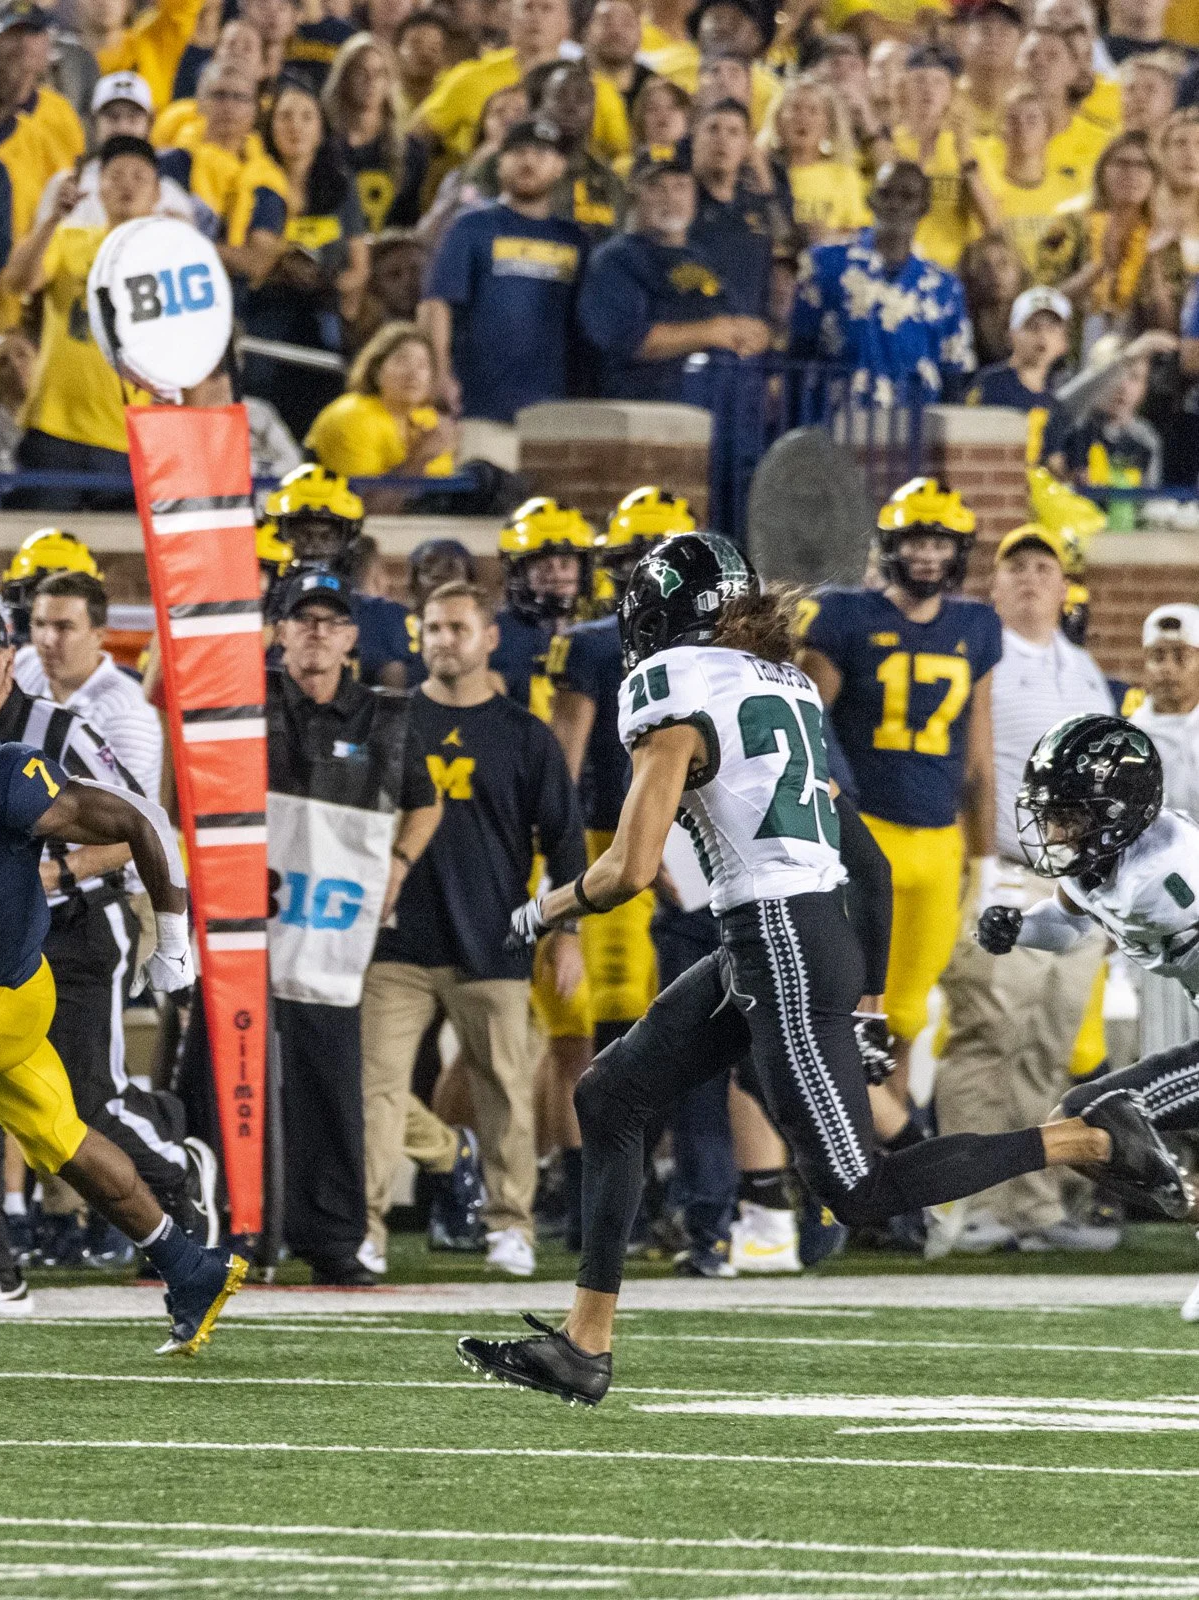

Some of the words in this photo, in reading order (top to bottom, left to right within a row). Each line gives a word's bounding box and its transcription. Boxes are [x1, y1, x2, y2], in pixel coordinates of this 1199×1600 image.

[626, 664, 671, 715] 25
[741, 654, 814, 693] THOMPSO
[873, 653, 972, 757] 17
[22, 757, 59, 799] 7
[425, 755, 476, 800] M
[233, 1009, 254, 1137] Gilman
